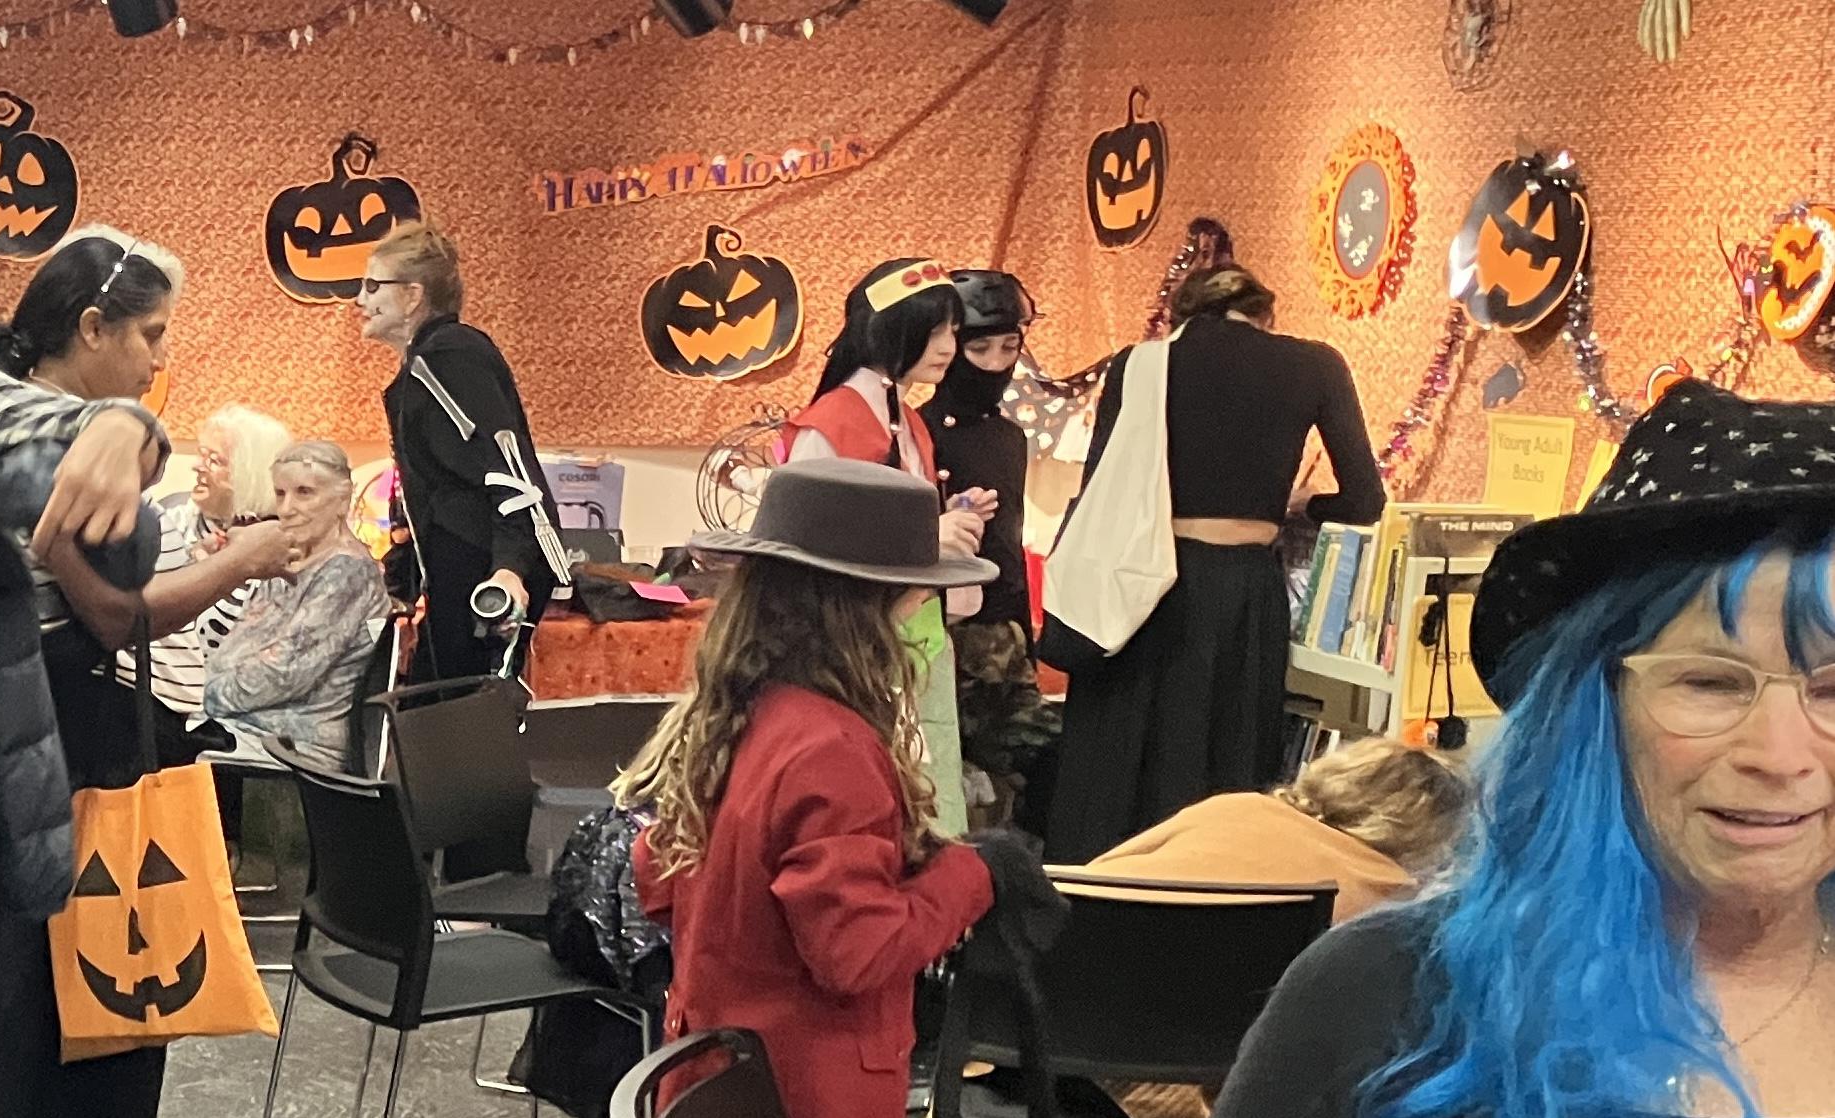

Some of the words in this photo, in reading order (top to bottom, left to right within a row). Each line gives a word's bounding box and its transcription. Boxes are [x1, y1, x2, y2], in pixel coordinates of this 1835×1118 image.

[1498, 433, 1532, 456] Young
[1533, 436, 1564, 456] Adult
[1513, 464, 1545, 484] Books
[1440, 521, 1470, 532] THE
[1471, 521, 1514, 532] MIND
